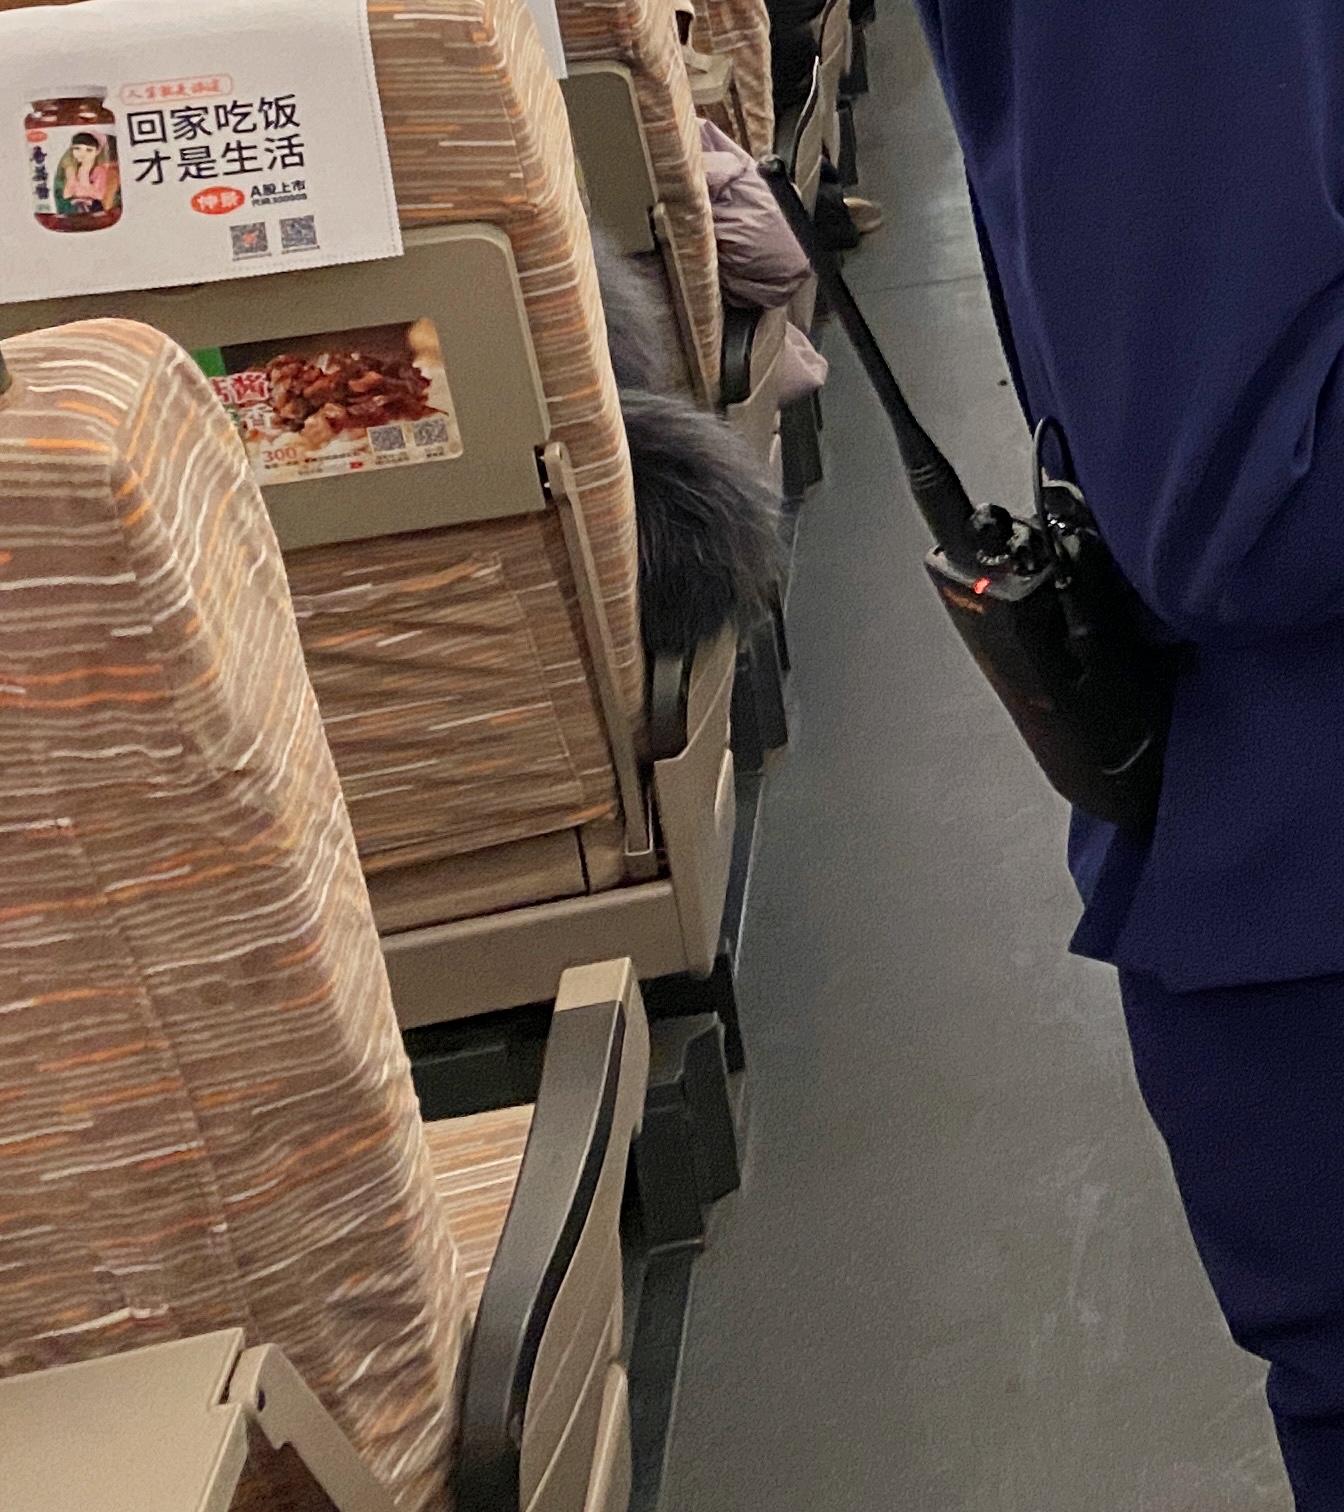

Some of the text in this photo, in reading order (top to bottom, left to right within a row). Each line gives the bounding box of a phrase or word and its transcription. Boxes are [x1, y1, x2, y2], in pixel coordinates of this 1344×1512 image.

[126, 93, 301, 146] 回家吃饭
[133, 133, 305, 185] 才是生活
[264, 447, 298, 463] 300
